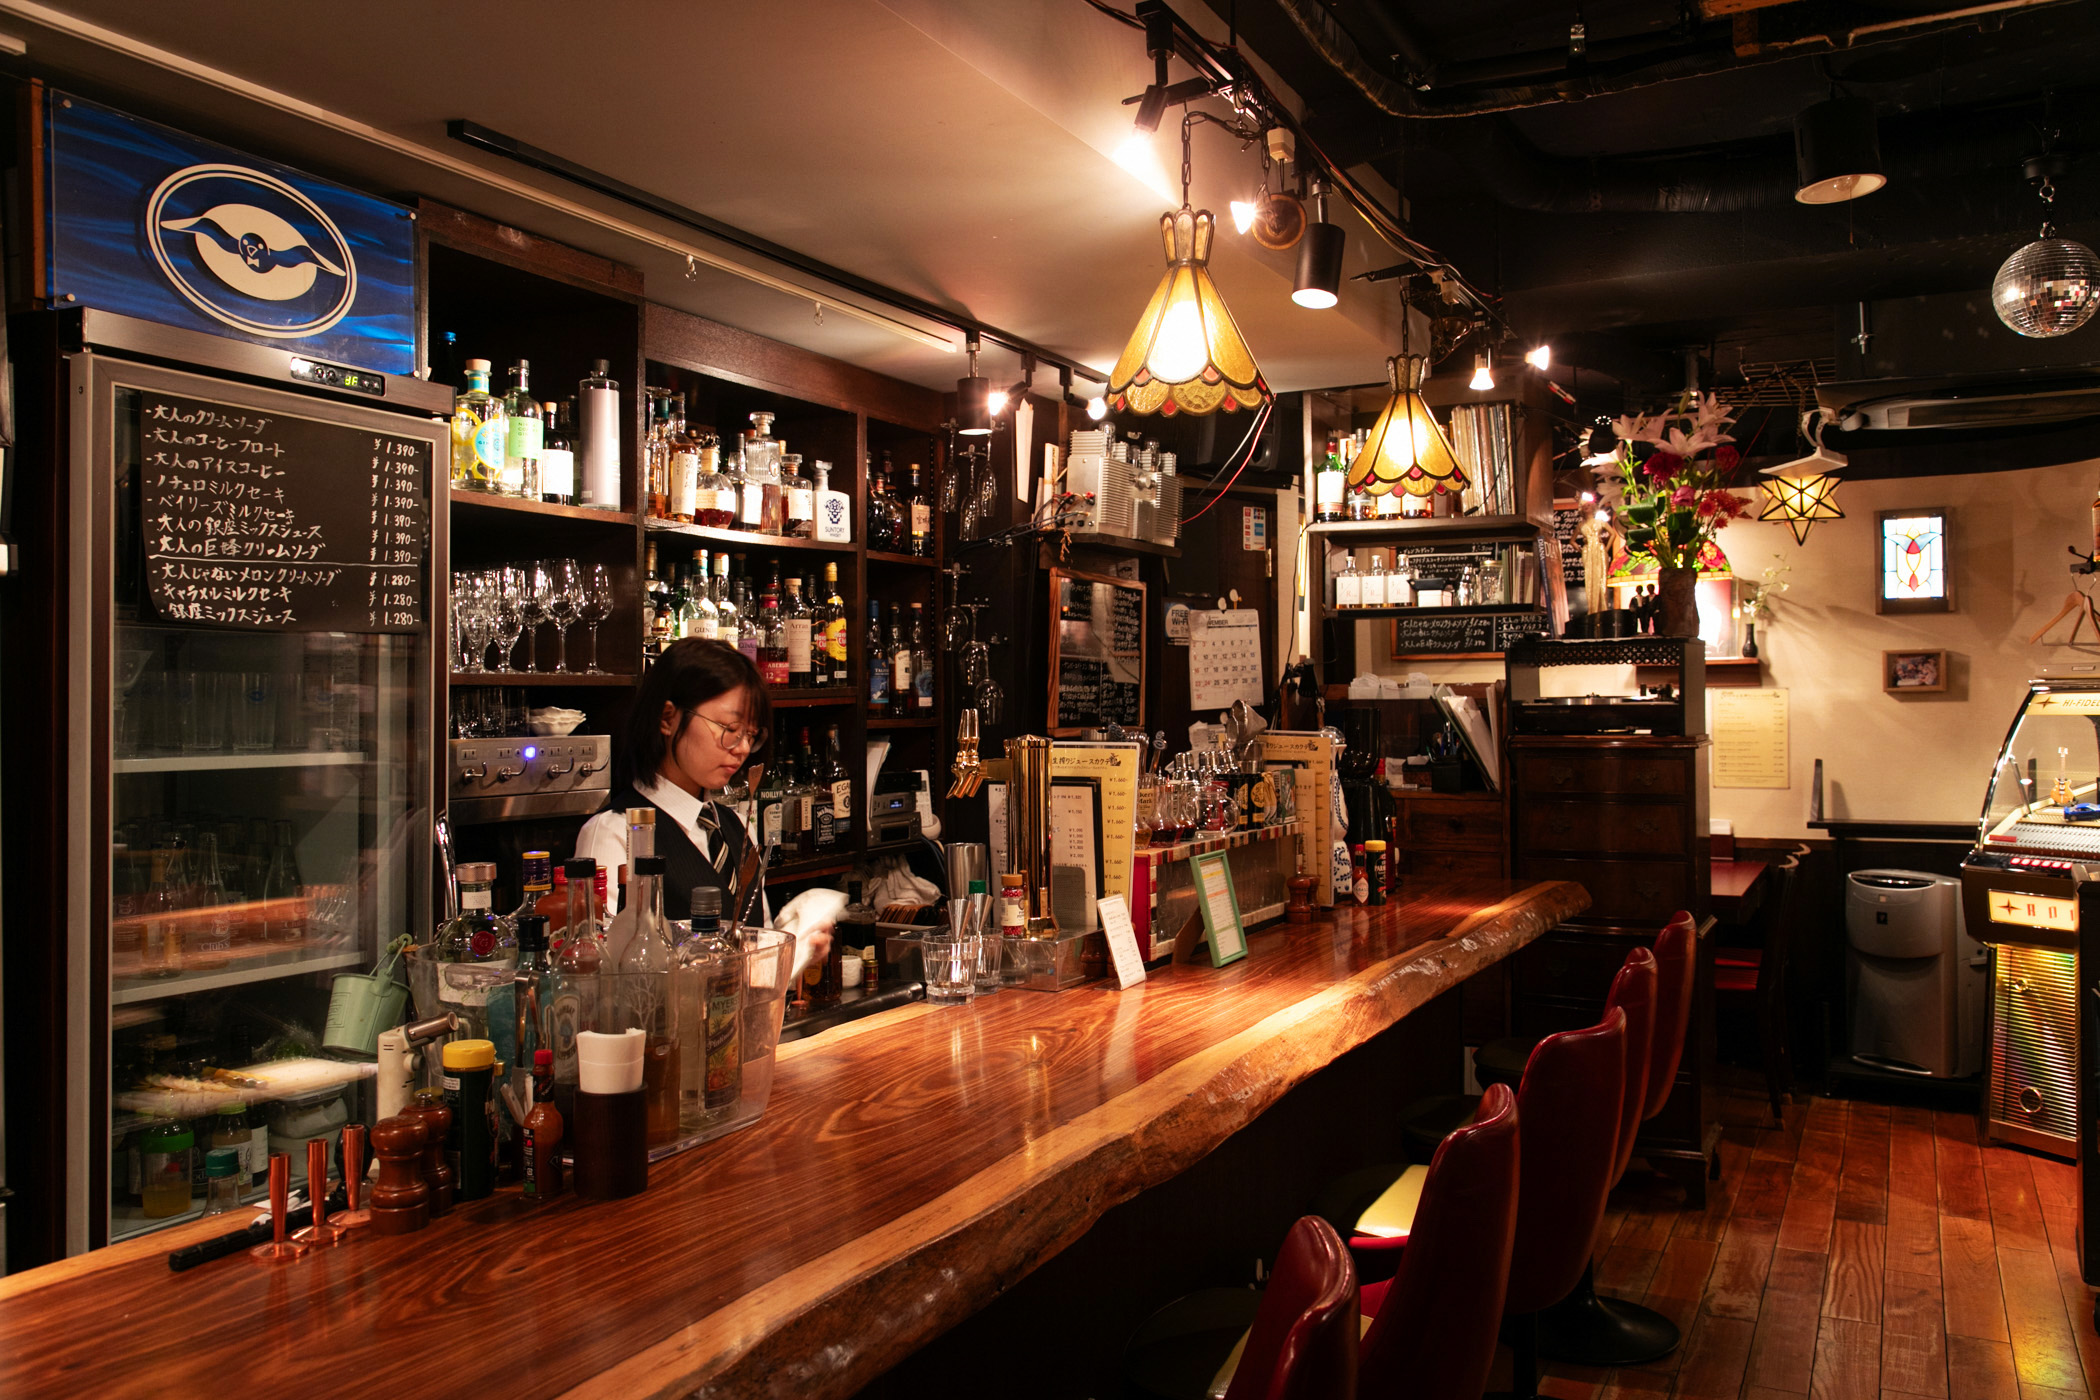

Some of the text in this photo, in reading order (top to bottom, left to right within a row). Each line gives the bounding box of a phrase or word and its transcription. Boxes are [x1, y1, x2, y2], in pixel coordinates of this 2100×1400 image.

[152, 427, 285, 458] 大人のコーヒーフロート
[153, 451, 286, 480] 大人のアイスコーヒー
[163, 583, 293, 603] キャラメルミルクセーキ
[169, 603, 297, 624] 銀座ミックスジュース
[1171, 609, 1188, 617] FREE
[1052, 756, 1112, 765] 生搾りジュースカクテ
[760, 790, 779, 799] NOILLY
[200, 942, 224, 951] Club
